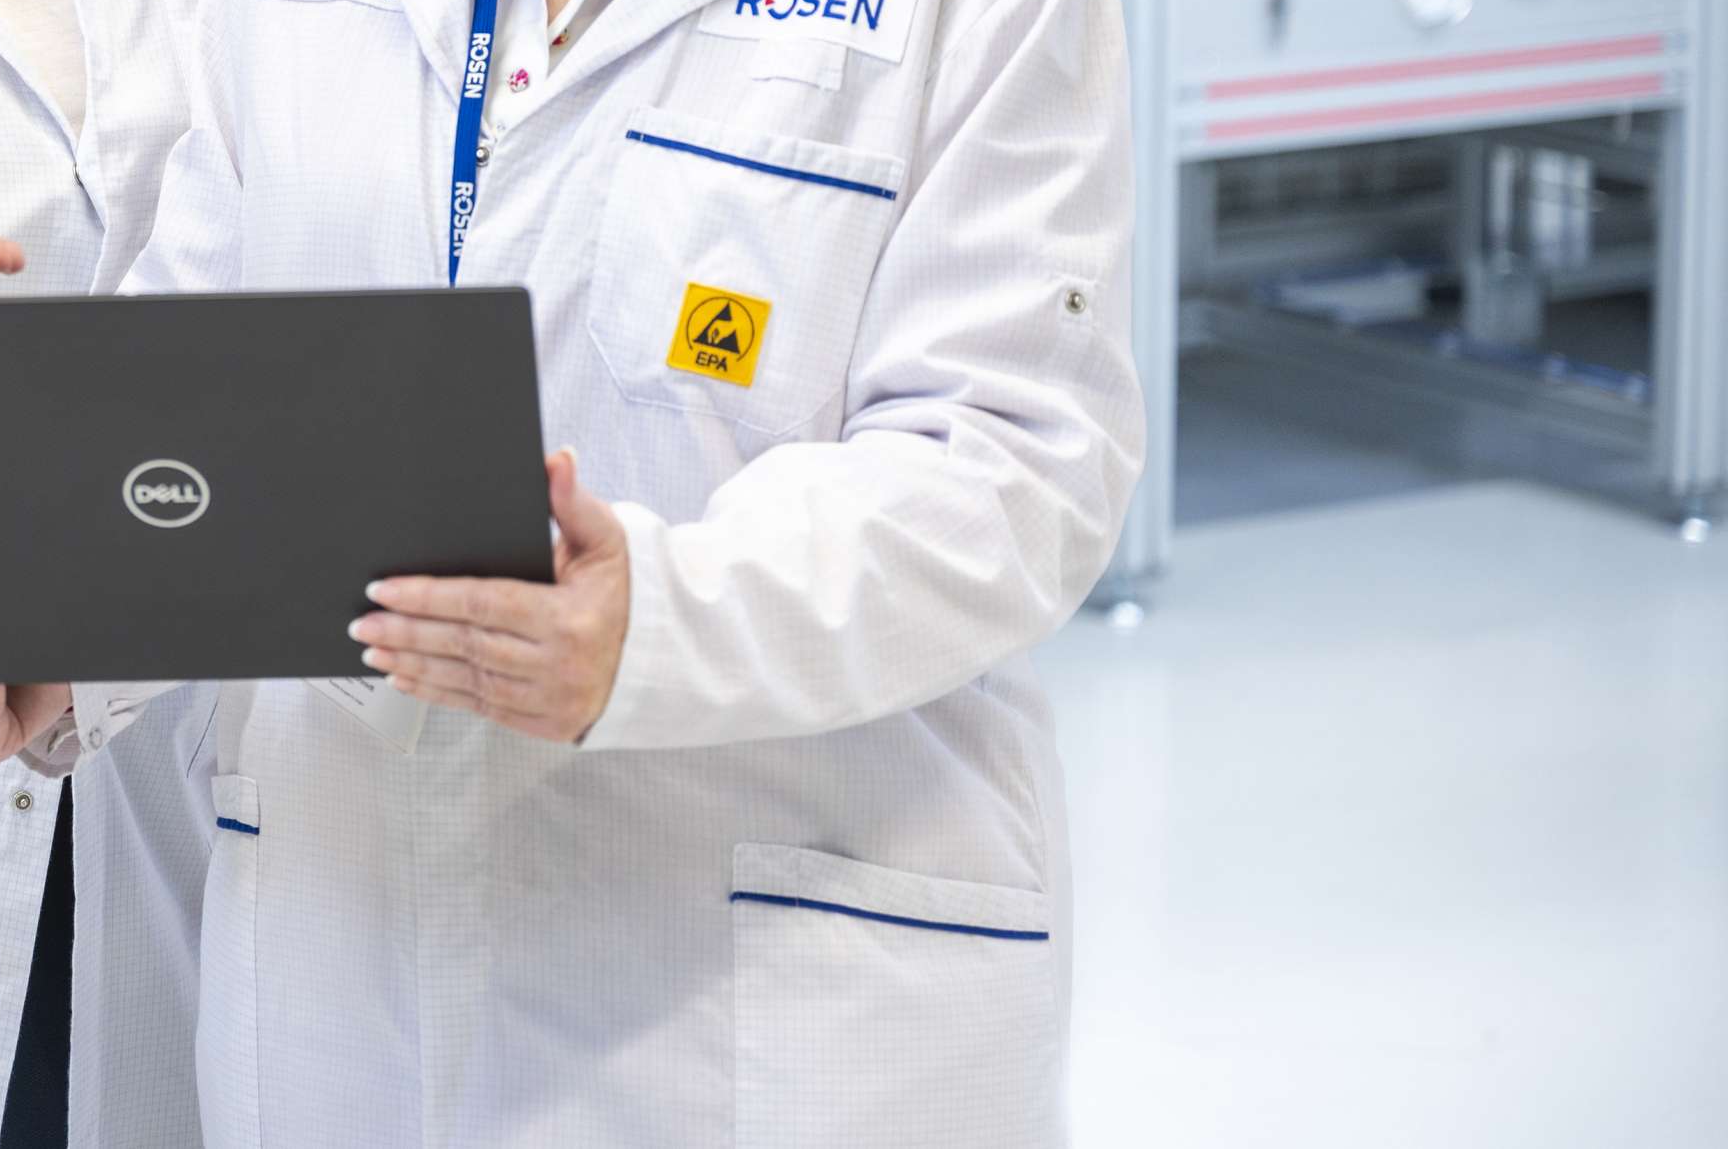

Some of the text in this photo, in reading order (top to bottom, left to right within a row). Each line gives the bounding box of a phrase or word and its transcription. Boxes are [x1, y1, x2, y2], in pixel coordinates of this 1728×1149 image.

[464, 33, 491, 98] ROSEN
[695, 350, 728, 373] EPA
[134, 483, 202, 505] DELL
